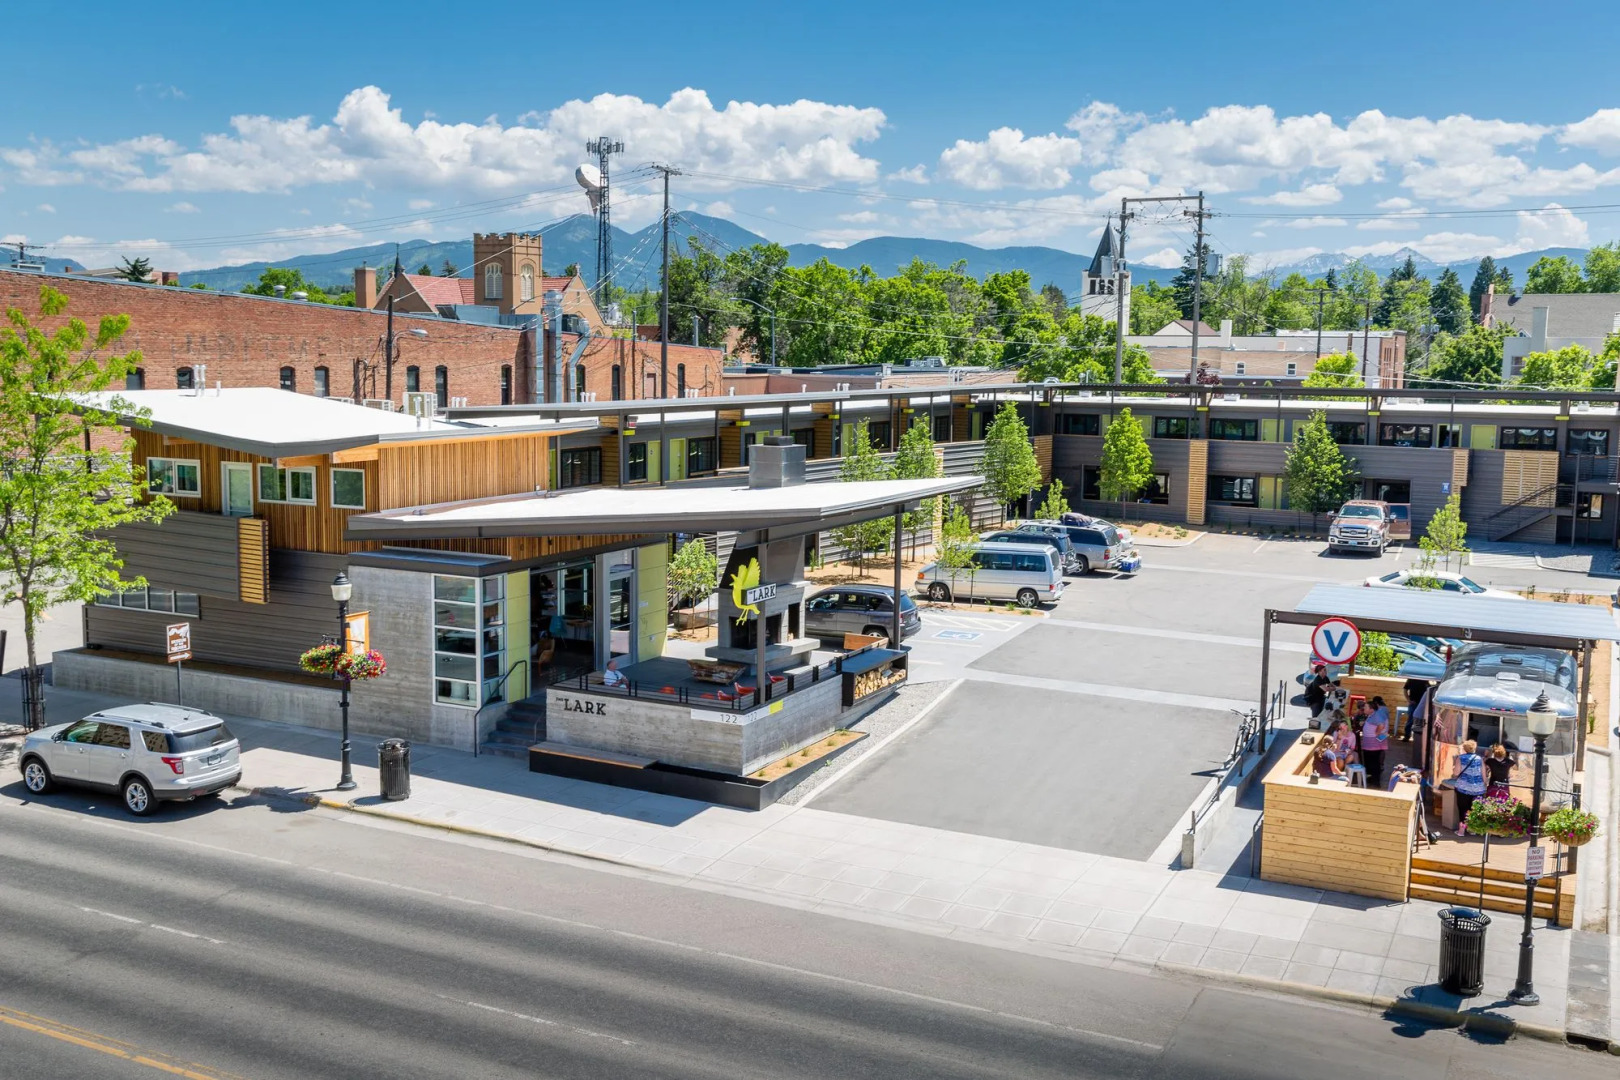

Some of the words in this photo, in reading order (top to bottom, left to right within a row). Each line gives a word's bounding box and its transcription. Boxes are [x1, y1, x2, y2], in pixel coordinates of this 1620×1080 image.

[753, 585, 775, 601] LARK
[1323, 629, 1350, 657] V
[563, 698, 607, 716] LARK
[720, 713, 738, 724] 122
